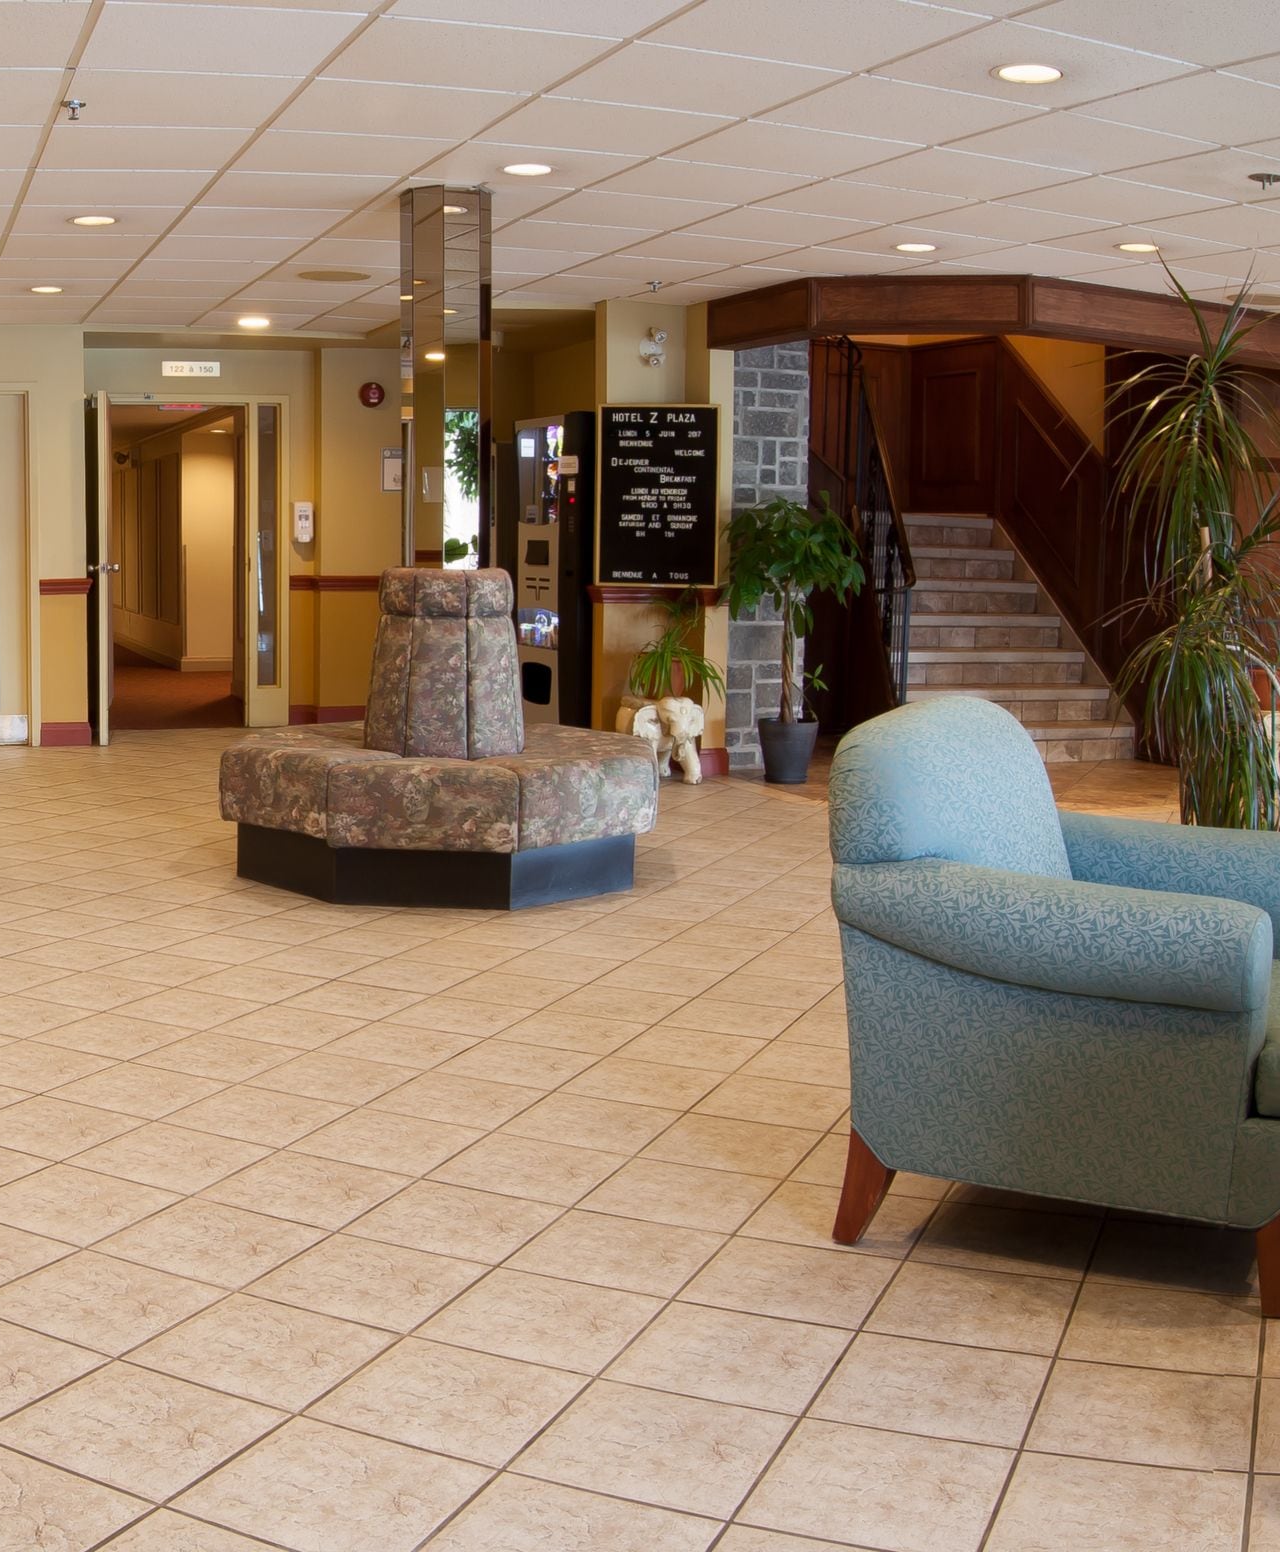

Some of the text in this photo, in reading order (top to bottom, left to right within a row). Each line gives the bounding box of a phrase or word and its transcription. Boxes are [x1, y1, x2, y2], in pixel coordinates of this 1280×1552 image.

[199, 366, 214, 374] 150
[612, 412, 696, 424] HOTEL Z PLAZA
[618, 430, 638, 438] LUNDI
[645, 430, 651, 438] 5
[619, 440, 654, 448] BIENVENUE
[674, 449, 706, 457] WELCOME
[633, 466, 675, 474] CONTINENTAL
[660, 488, 688, 496] VENDREDI
